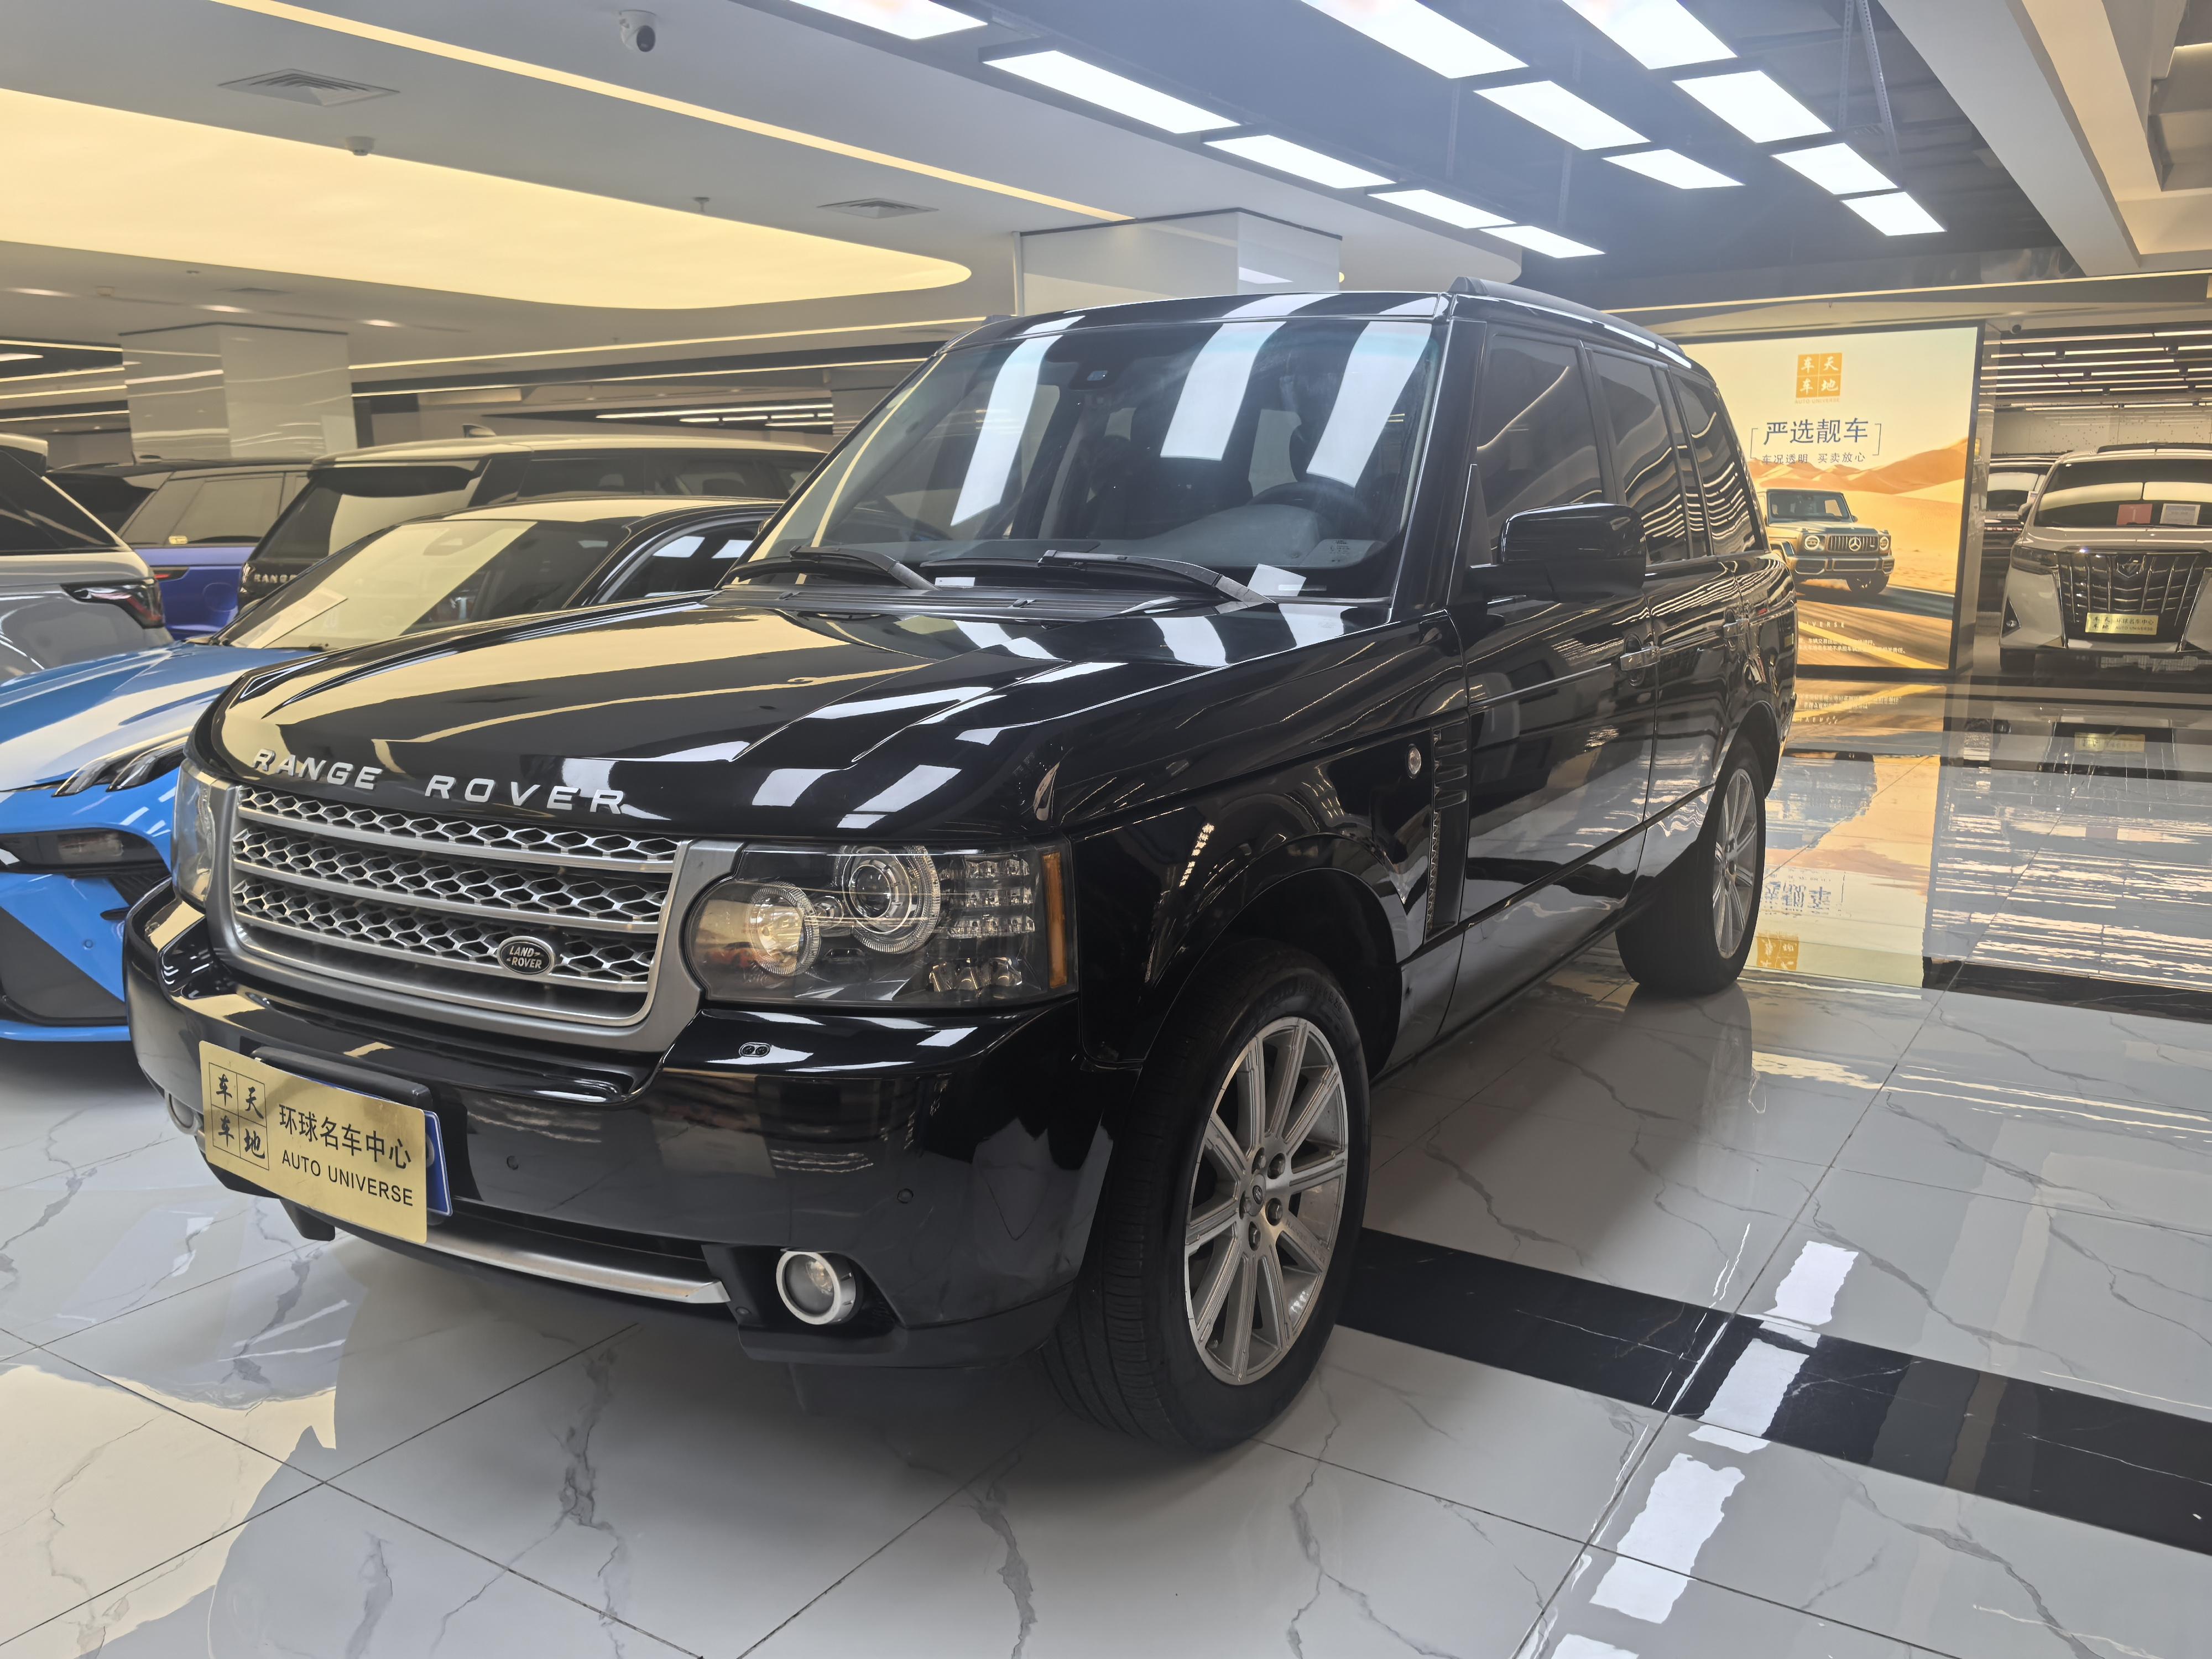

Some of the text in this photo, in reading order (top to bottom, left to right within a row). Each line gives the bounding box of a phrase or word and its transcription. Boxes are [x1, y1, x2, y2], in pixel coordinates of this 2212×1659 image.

[1763, 418, 1869, 446] 严选靓车
[1762, 452, 1866, 465] 车况透明 买卖放心
[1798, 620, 1844, 629] IVERSE
[251, 749, 625, 815] RANGE ROVER
[509, 946, 535, 957] LAND
[512, 956, 542, 969] ROVER
[279, 1103, 411, 1170] 环球名车中心
[281, 1149, 413, 1207] AUTO UNIVERSE
